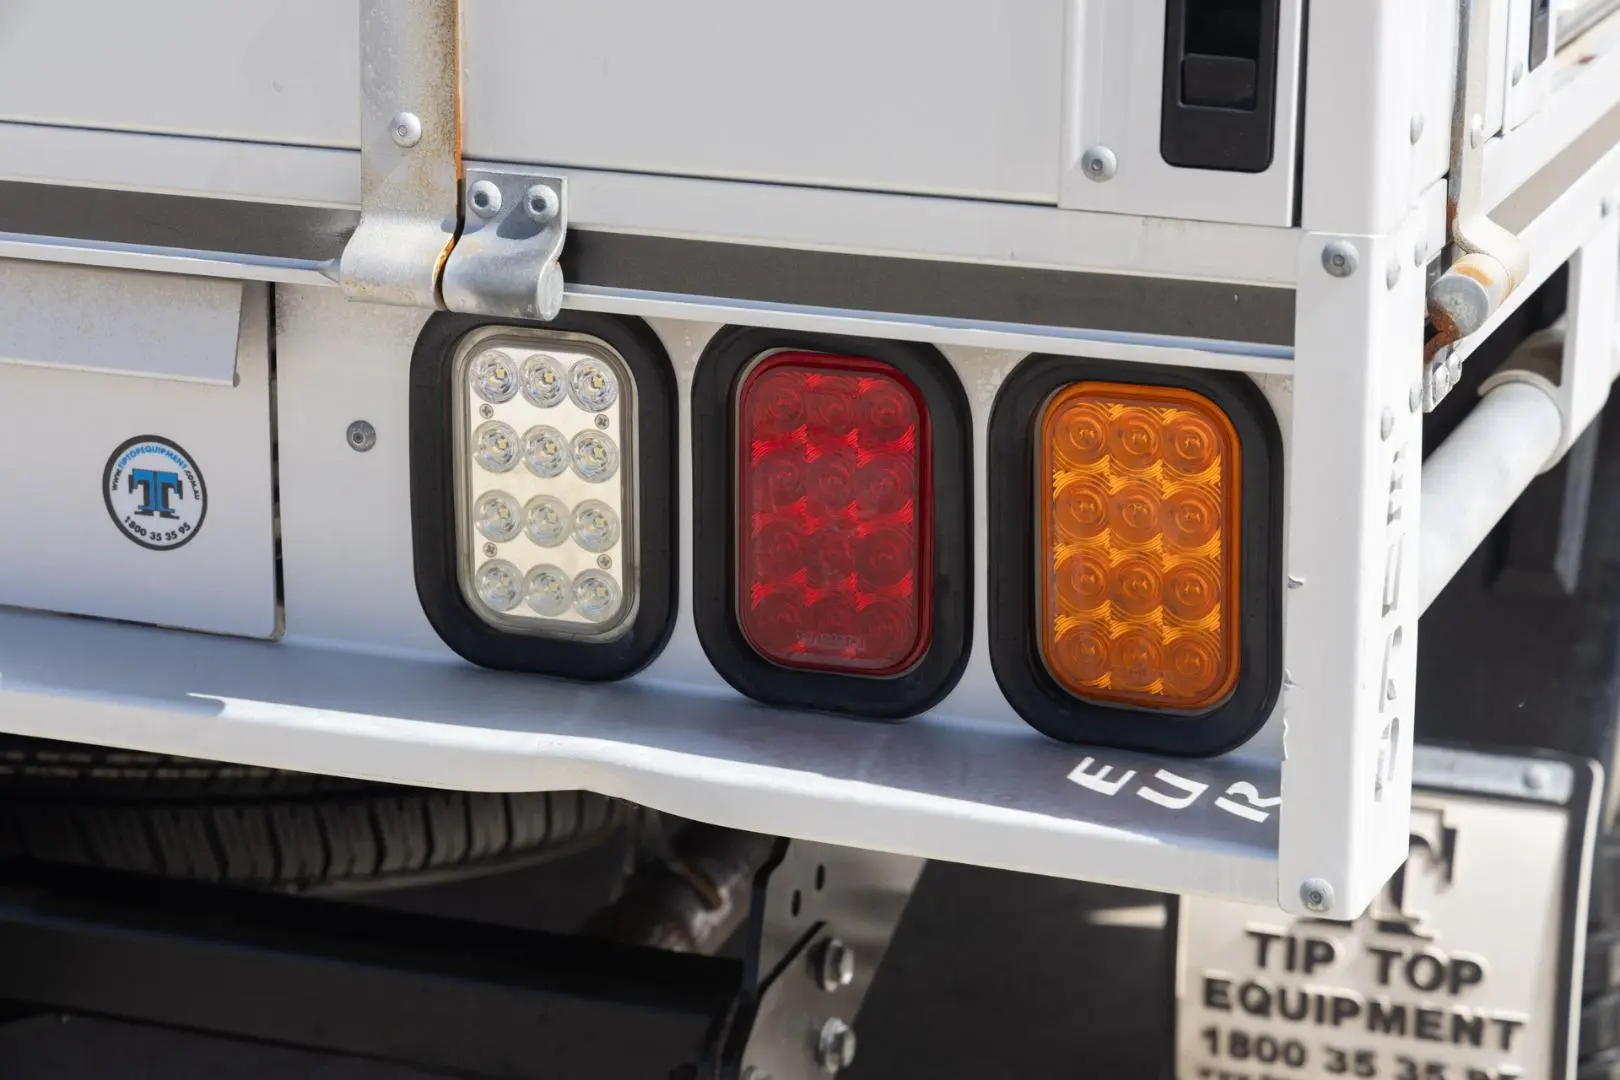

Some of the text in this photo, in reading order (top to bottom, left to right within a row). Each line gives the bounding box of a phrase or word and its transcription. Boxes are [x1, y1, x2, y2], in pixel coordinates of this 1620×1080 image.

[124, 516, 191, 541] 1800 35 35 95
[1245, 927, 1487, 997] TIP TOP
[1202, 976, 1528, 1052] EQUIPMENT
[1201, 1025, 1307, 1068] 1800
[1323, 1046, 1378, 1079] 35
